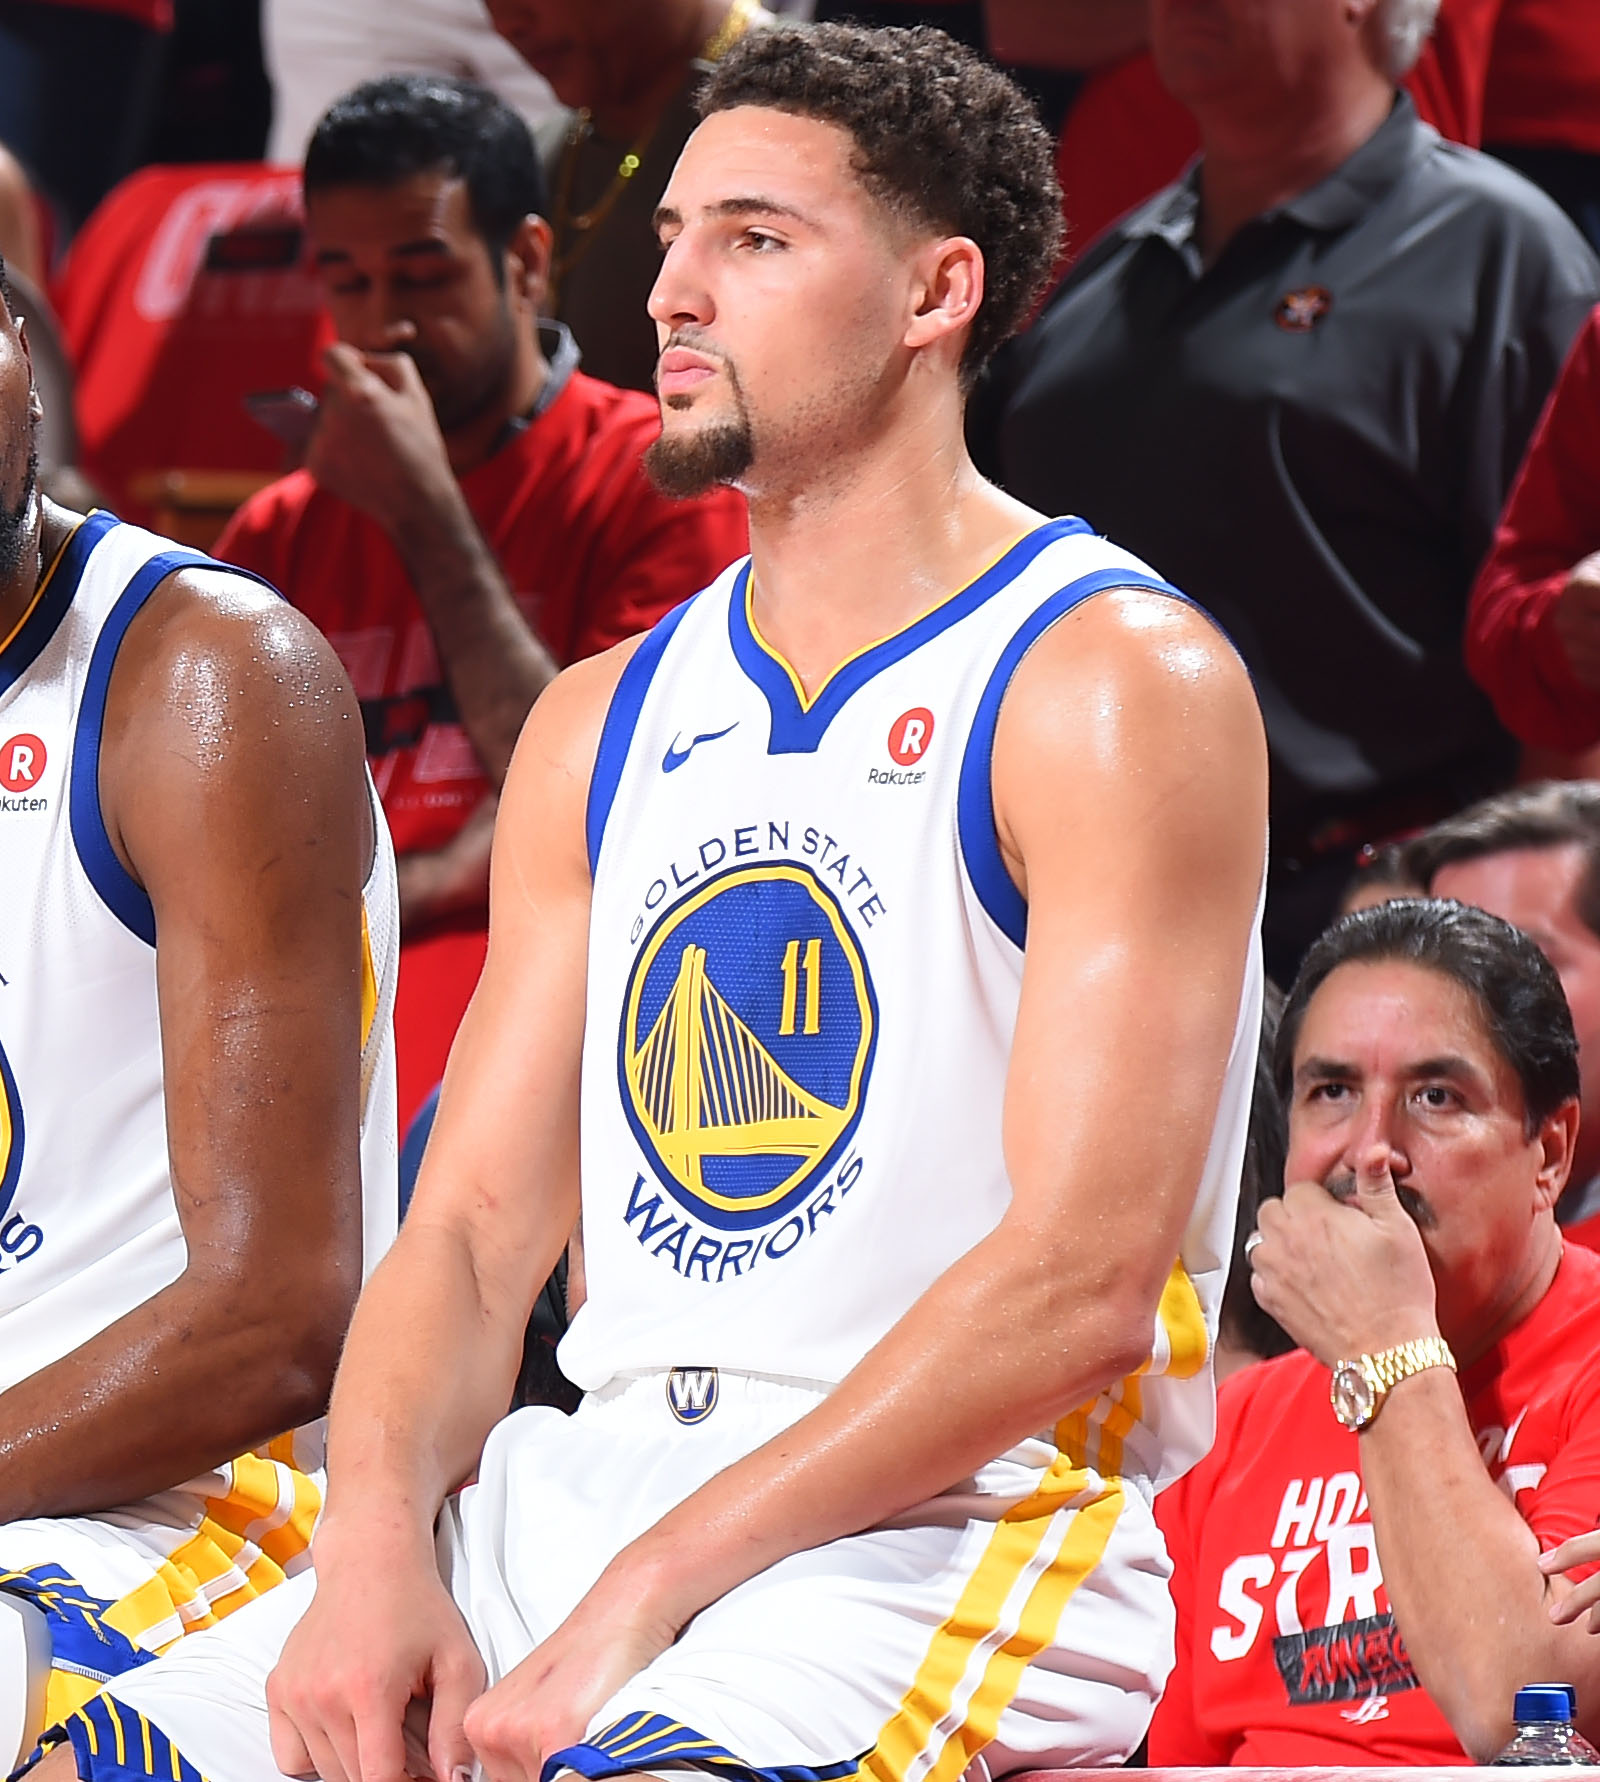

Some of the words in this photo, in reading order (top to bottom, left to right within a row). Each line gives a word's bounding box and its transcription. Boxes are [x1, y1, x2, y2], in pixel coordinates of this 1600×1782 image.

[630, 821, 790, 945] GOLDEN
[802, 827, 888, 929] STATE
[778, 938, 822, 1035] 11
[623, 1147, 864, 1283] WARRIORS
[670, 1370, 715, 1411] W
